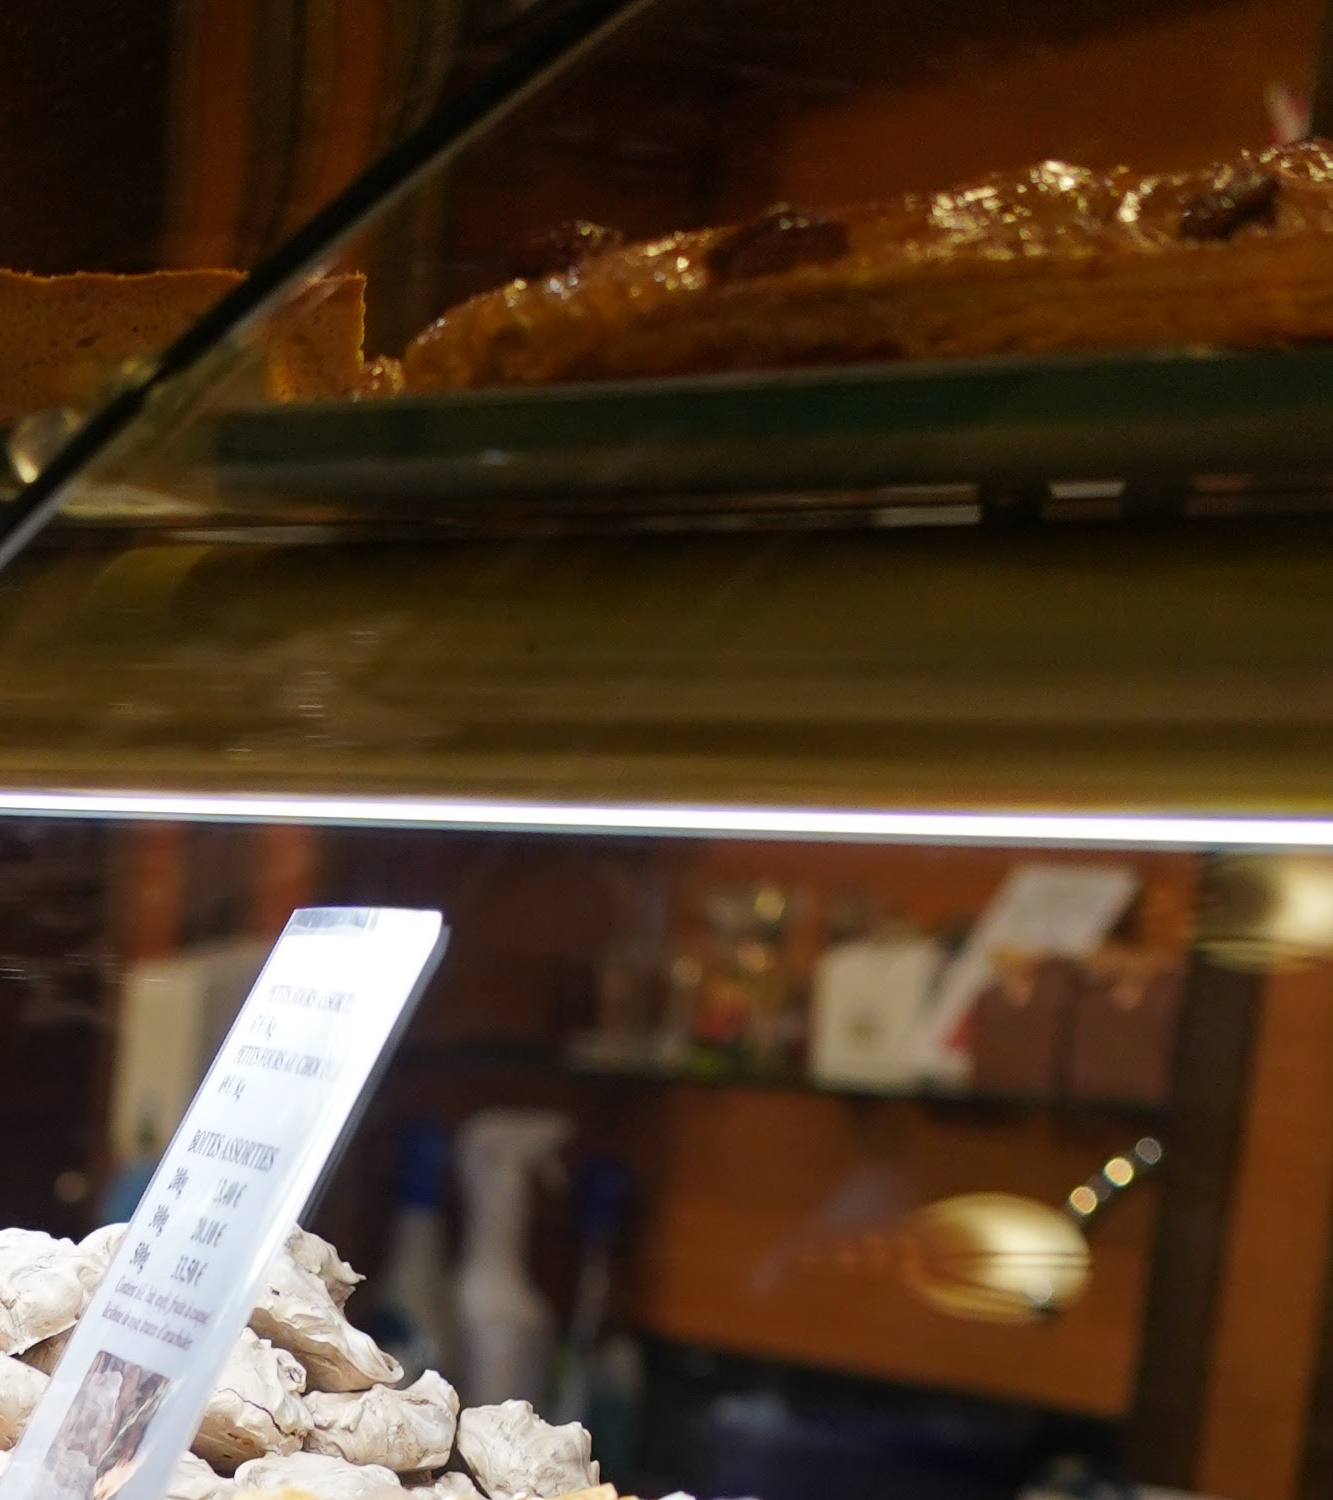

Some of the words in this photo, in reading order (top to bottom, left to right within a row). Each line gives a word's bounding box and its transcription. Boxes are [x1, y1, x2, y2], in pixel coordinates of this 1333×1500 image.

[187, 1129, 226, 1158] BOITES
[220, 1137, 281, 1172] ASSORTIES
[232, 1184, 248, 1208] €
[212, 1222, 229, 1248] €
[194, 1262, 209, 1287] €
